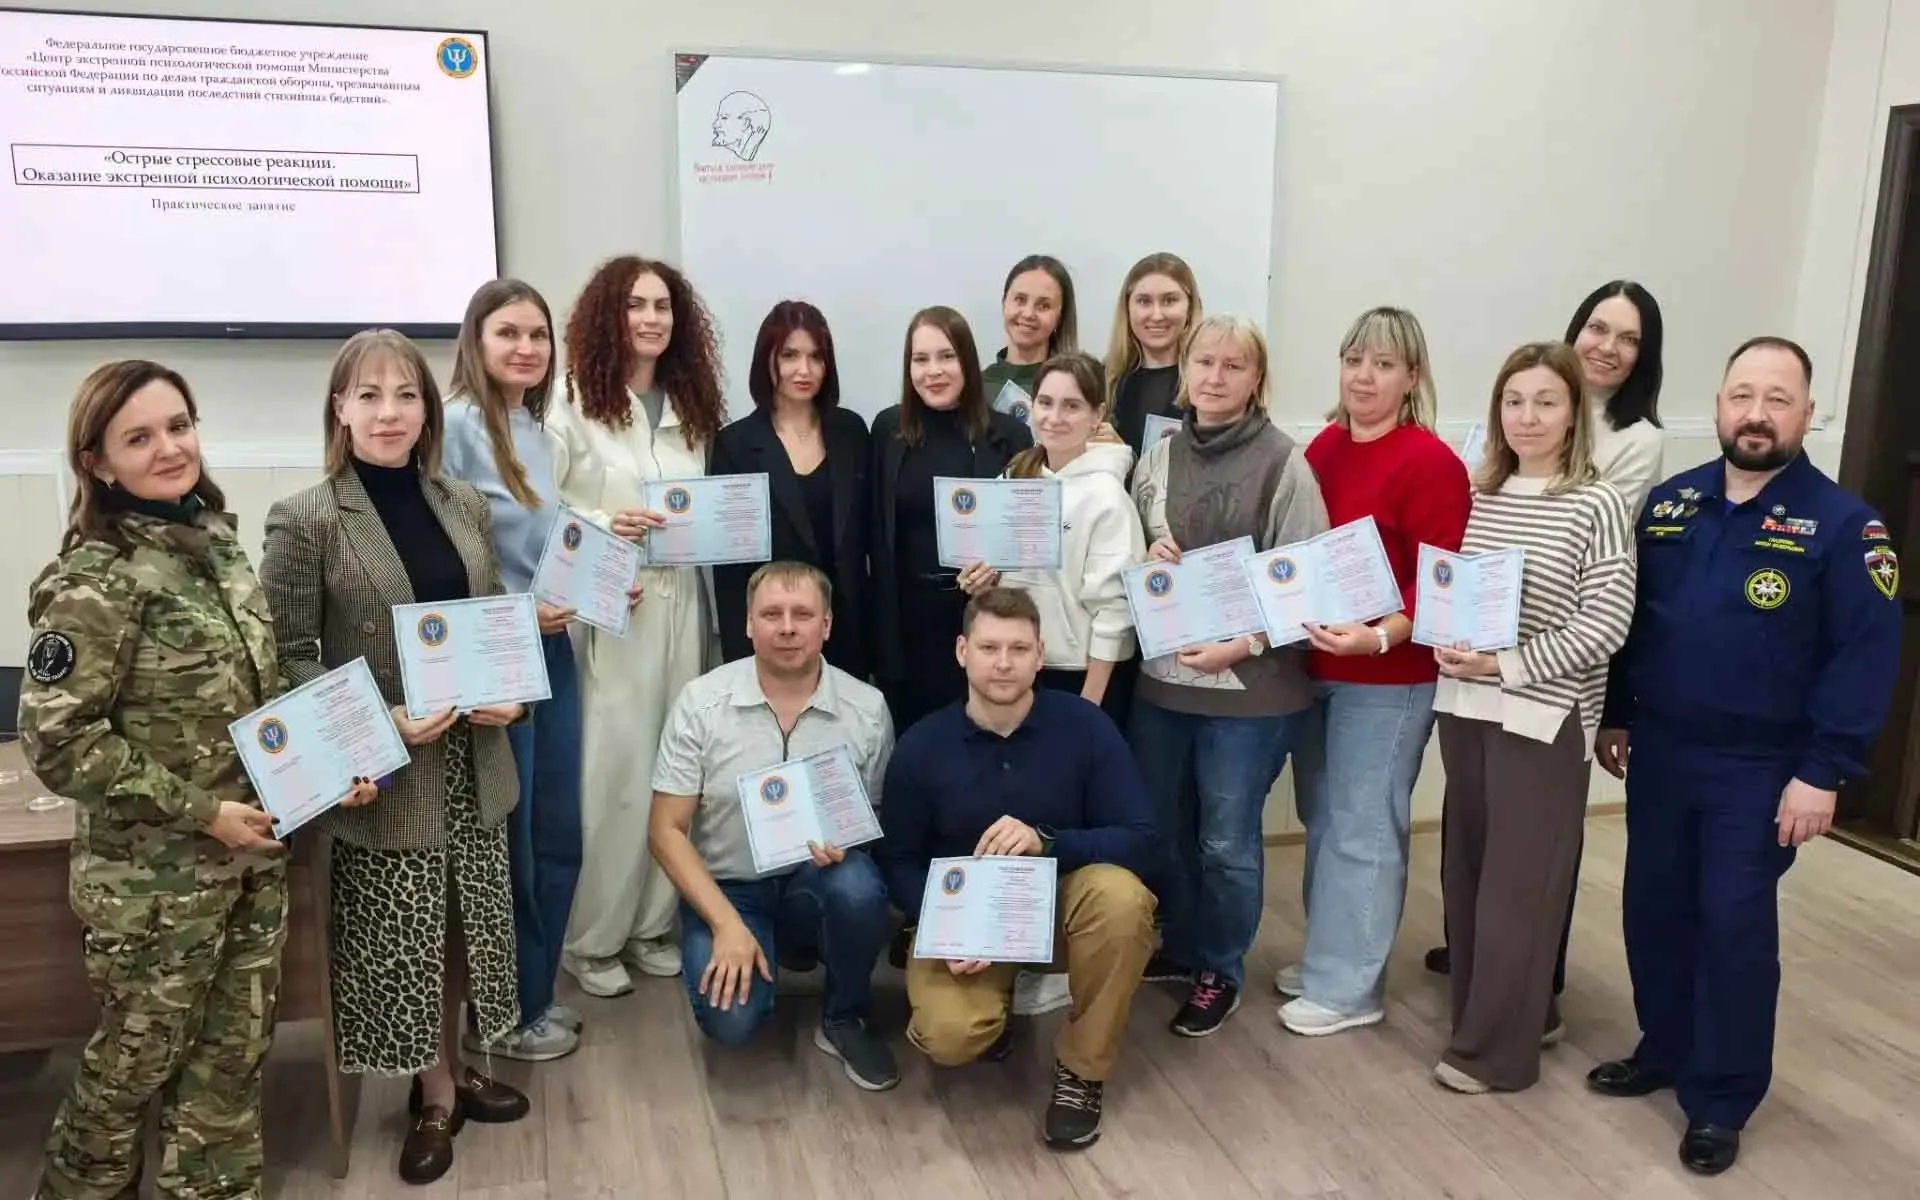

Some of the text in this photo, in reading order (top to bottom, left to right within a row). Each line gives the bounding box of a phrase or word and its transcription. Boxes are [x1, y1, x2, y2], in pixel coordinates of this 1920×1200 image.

[45, 37, 369, 63] Федеральное государственное бюджетное учреждение
[75, 54, 147, 67] экстренной
[149, 57, 252, 72] психологической
[256, 62, 306, 74] помощи
[307, 63, 390, 77] Министерства
[0, 66, 67, 78] оссийской
[69, 68, 139, 82] Федерации
[142, 73, 158, 82] по
[160, 74, 197, 84] делам
[200, 75, 278, 88] гражданской
[27, 83, 95, 95] ситуациям
[98, 86, 106, 95] и
[109, 86, 185, 98] ликвидации
[187, 88, 262, 101] последствий
[103, 150, 337, 172] «Острые стрессовые реакции.
[22, 167, 412, 190] Оказание экстренной психологической помощи»
[151, 198, 296, 212] Практическое занятие
